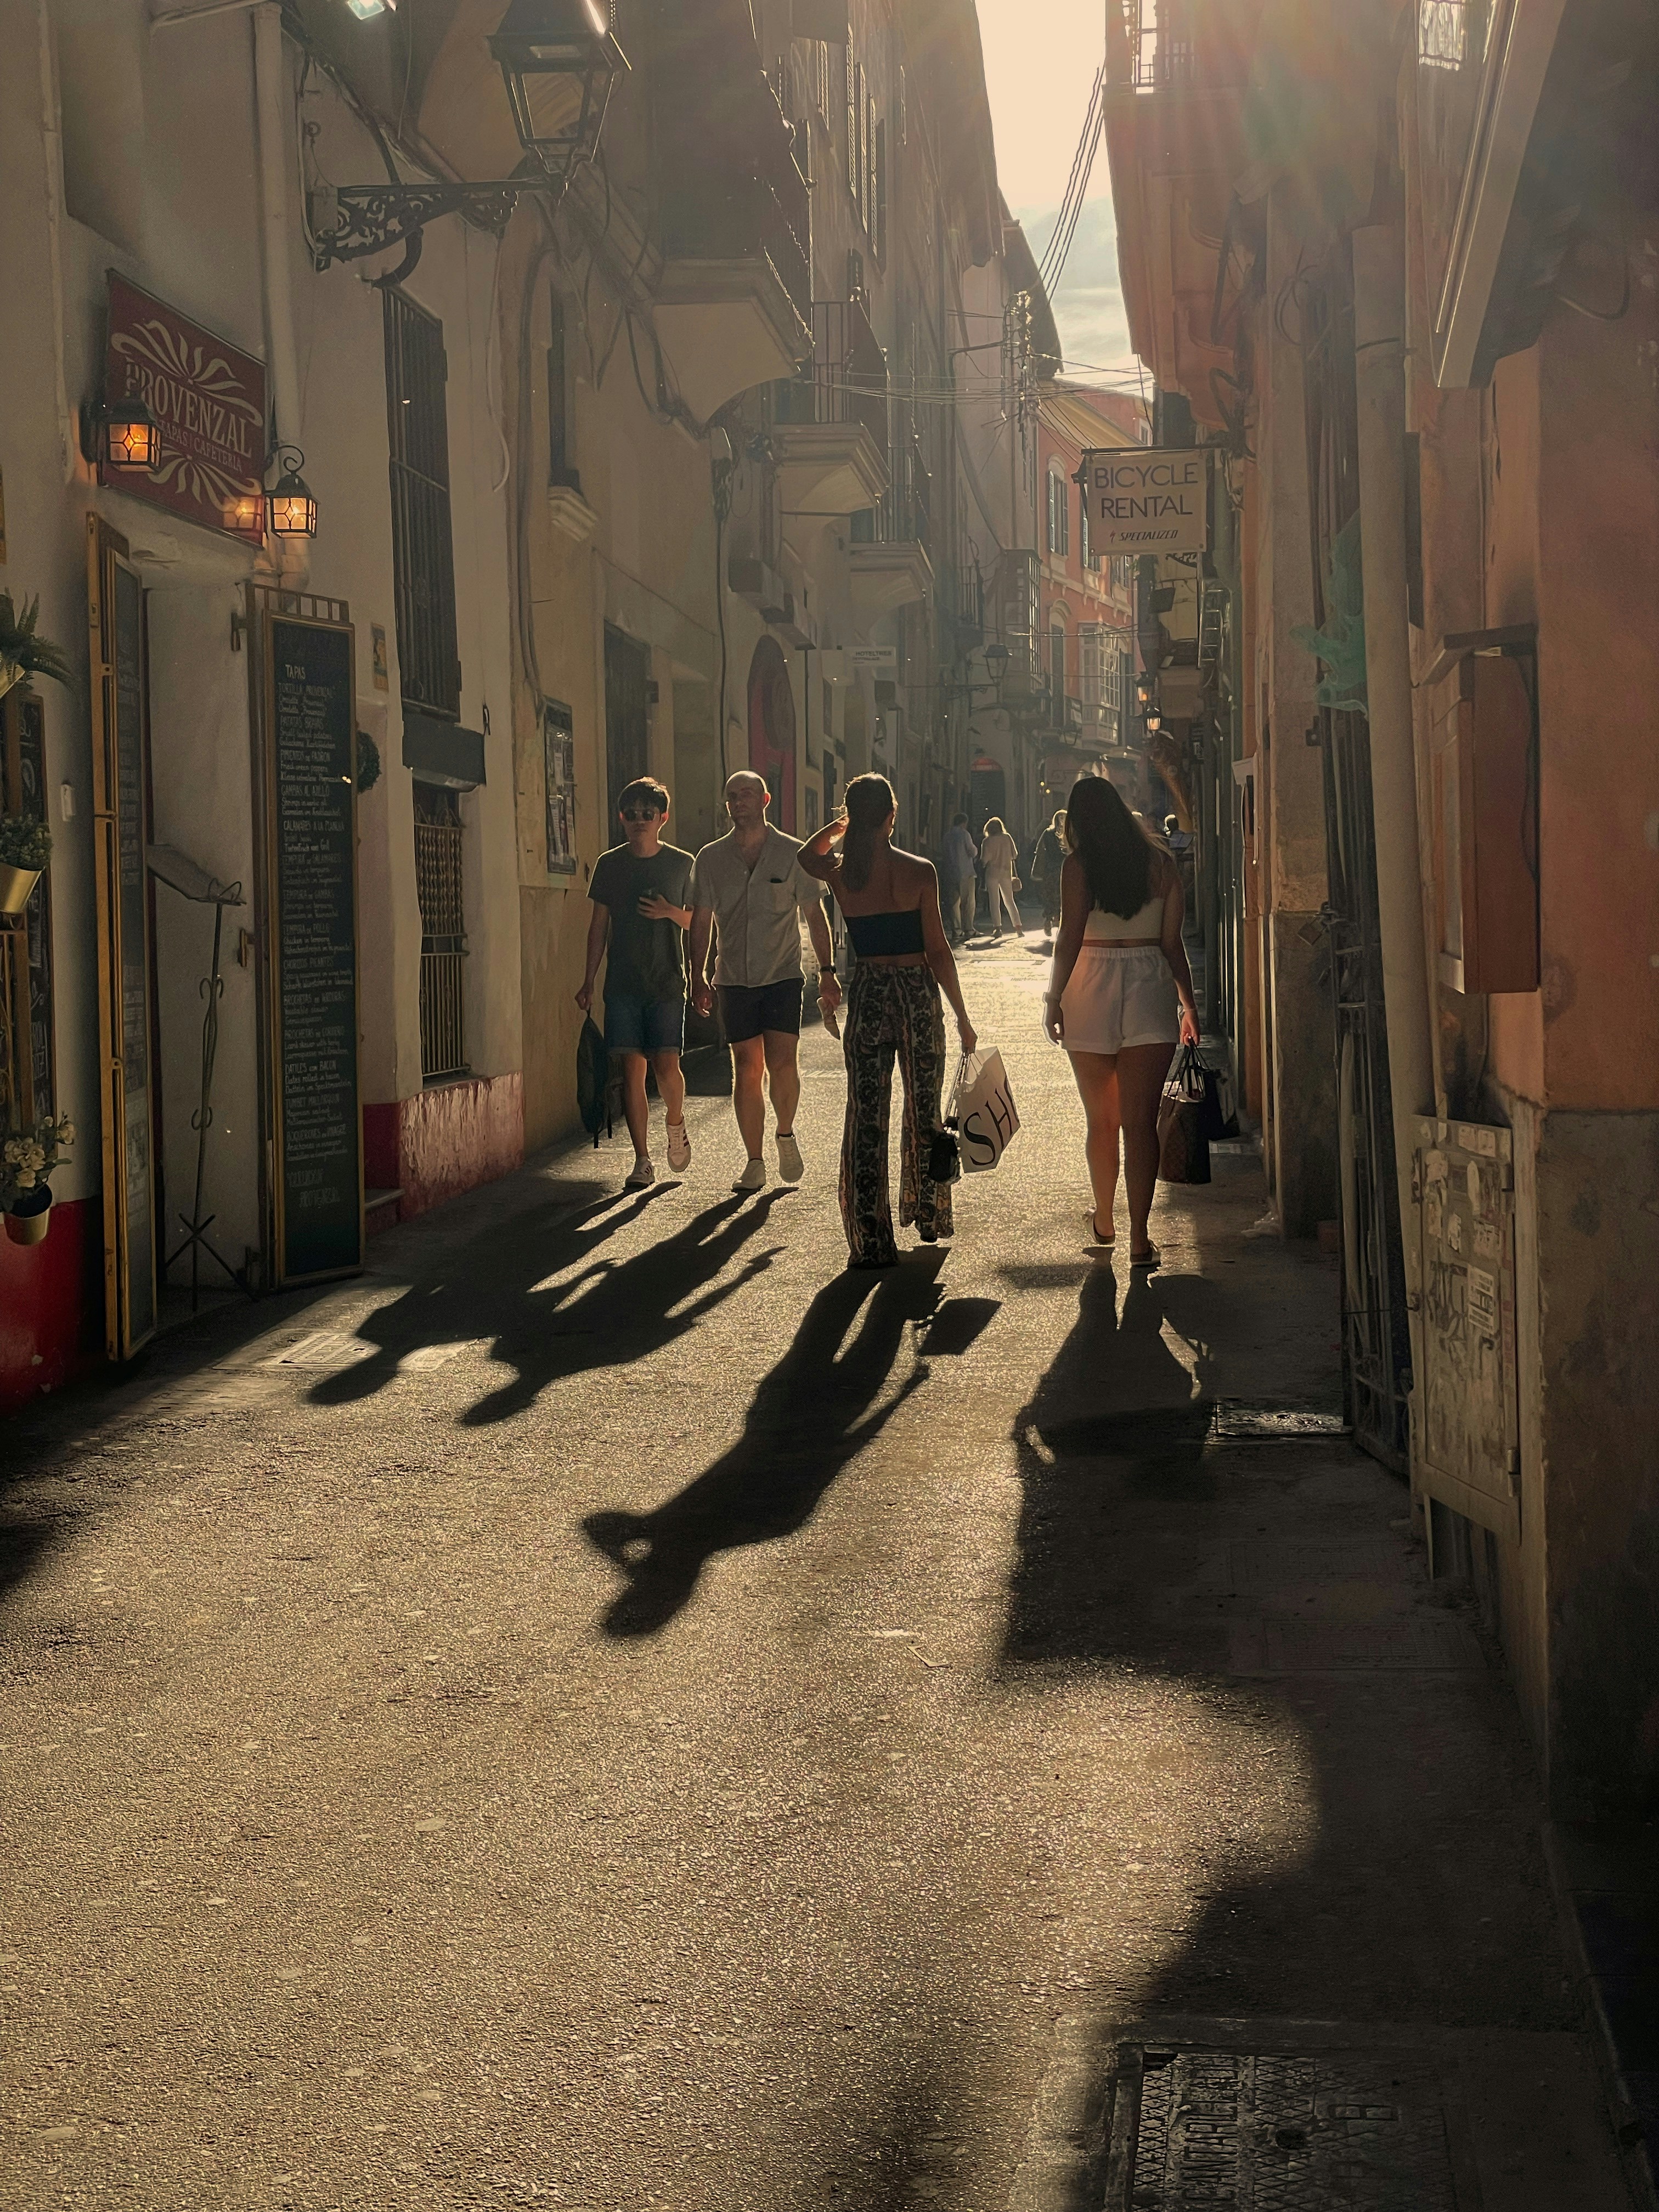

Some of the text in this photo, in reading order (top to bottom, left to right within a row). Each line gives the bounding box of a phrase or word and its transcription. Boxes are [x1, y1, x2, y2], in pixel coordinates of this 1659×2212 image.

[126, 356, 252, 458] PROVENZAL
[194, 438, 243, 473] CAFETERIA
[1094, 462, 1198, 489] BICYCLE
[1101, 494, 1193, 519] RENTAL
[1119, 529, 1178, 541] SPECIALIZED
[285, 664, 306, 680] TAPAS
